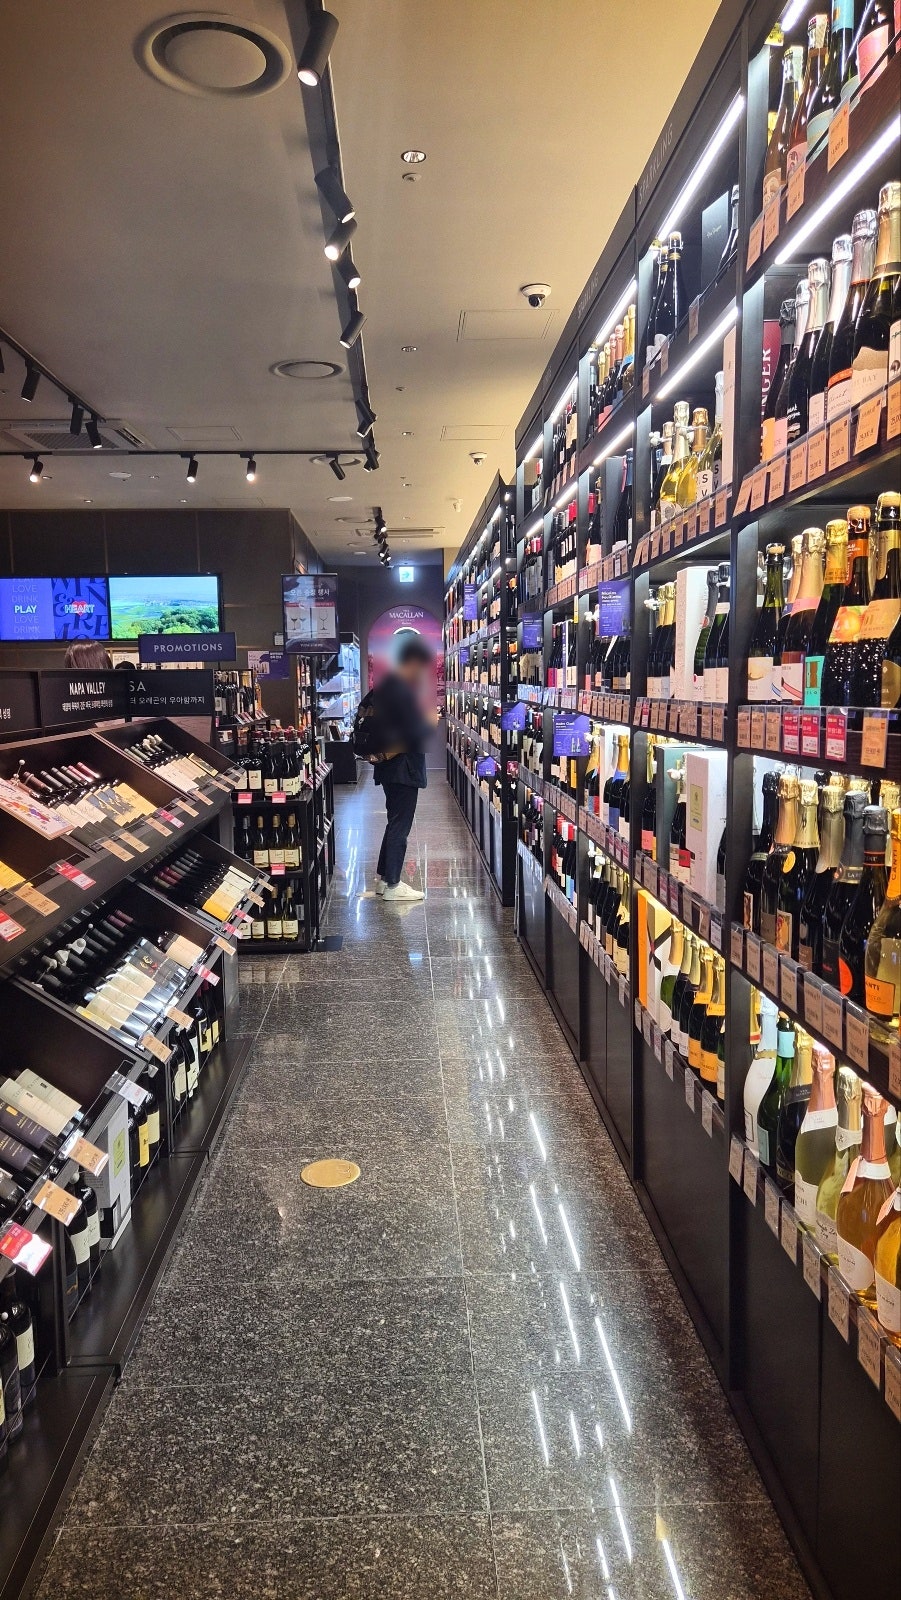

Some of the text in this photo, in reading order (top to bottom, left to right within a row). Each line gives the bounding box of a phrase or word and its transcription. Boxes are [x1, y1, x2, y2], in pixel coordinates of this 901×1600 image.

[14, 604, 37, 613] PLAY
[64, 604, 95, 613] HEART
[153, 643, 223, 653] PROMOTIONS
[69, 682, 106, 695] NAPA VALLEY
[139, 696, 167, 705] 오레곤의
[169, 696, 205, 705] 우아함까지
